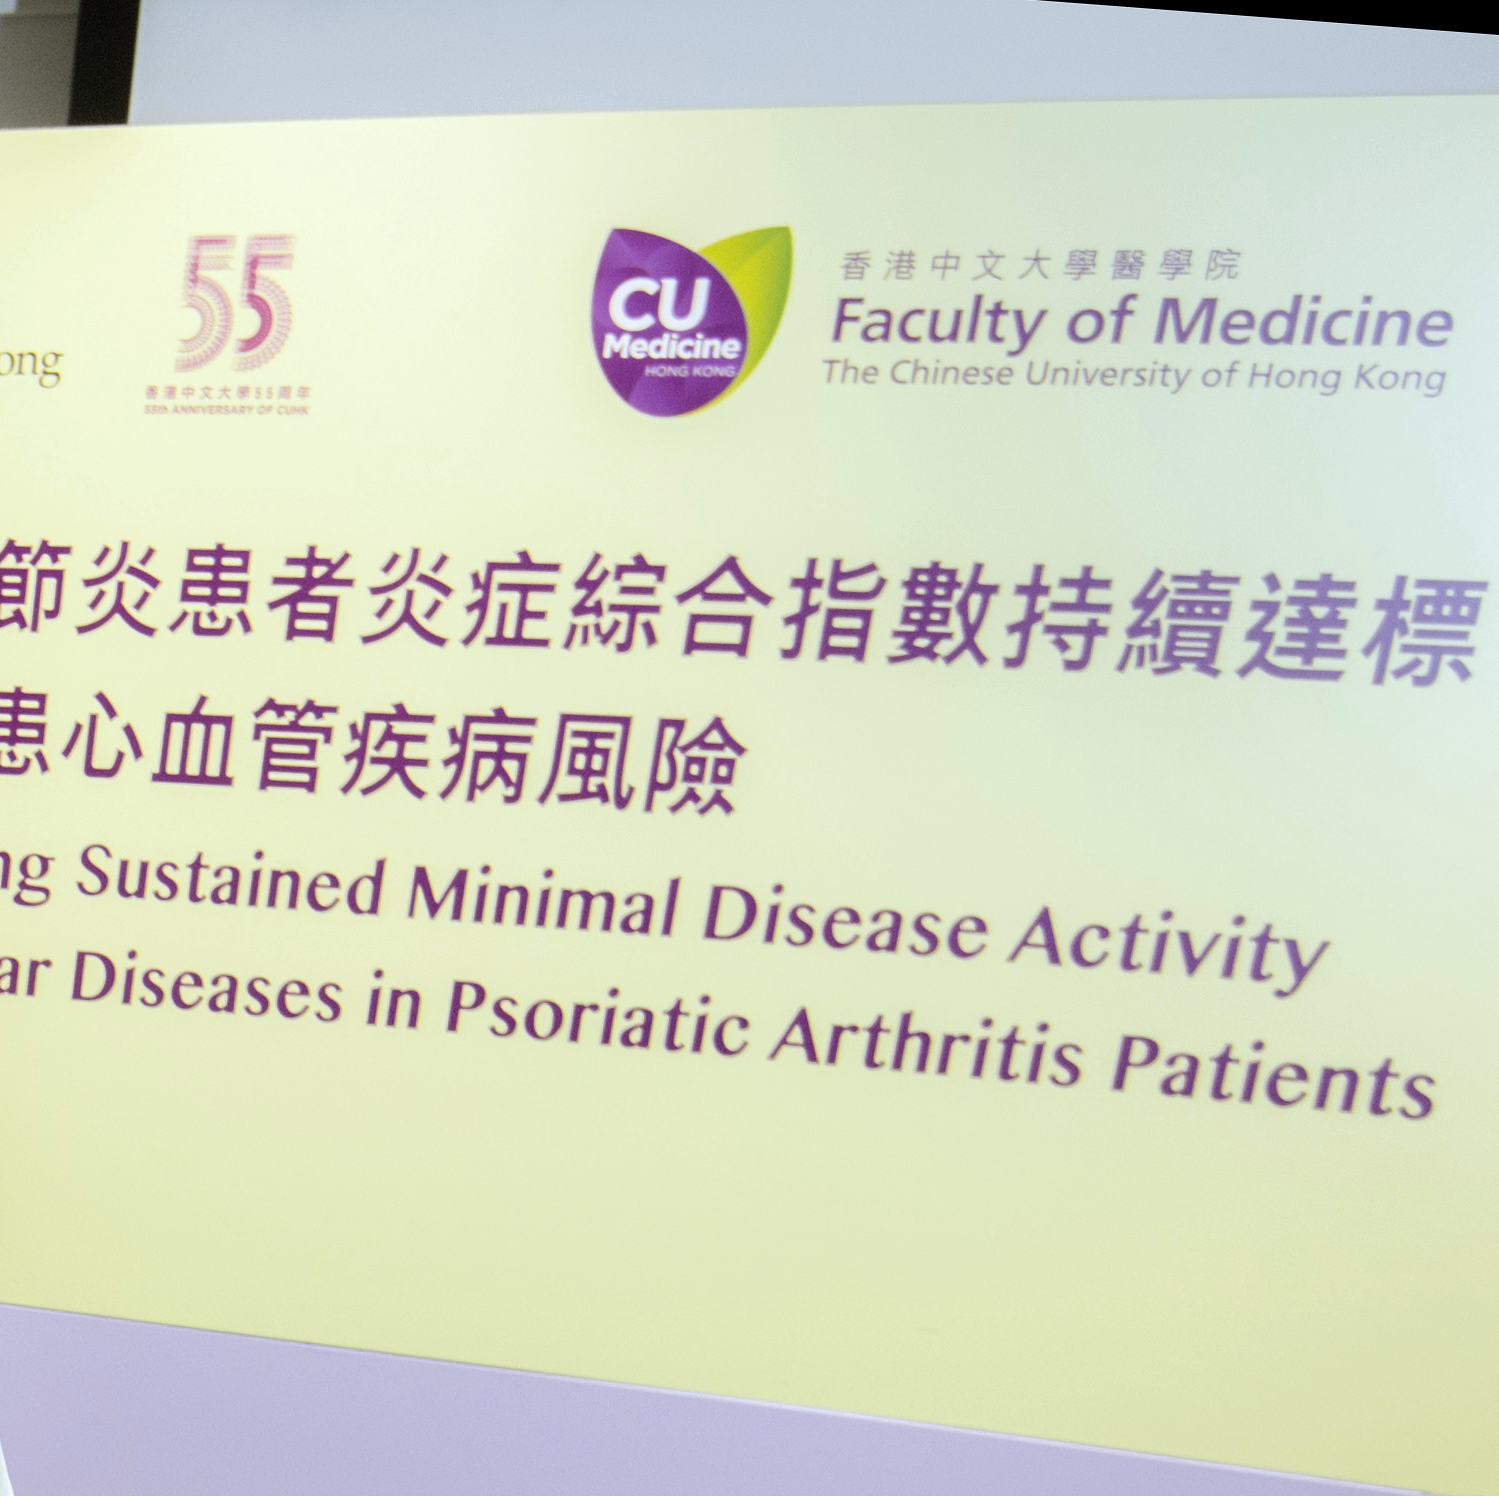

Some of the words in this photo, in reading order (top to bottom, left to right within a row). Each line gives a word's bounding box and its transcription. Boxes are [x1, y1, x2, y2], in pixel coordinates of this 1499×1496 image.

[840, 248, 1242, 282] 香港中文大學醫學院
[176, 235, 295, 373] 55
[609, 277, 711, 332] CU
[831, 293, 1048, 357] Faculty
[1067, 293, 1139, 344] of
[1154, 294, 1454, 347] Medicine
[603, 333, 742, 359] Medicine
[645, 365, 689, 378] HONG
[693, 365, 737, 379] KONG
[823, 358, 879, 385] The
[891, 359, 1014, 386] Chinese
[1026, 360, 1192, 395] University
[1202, 360, 1241, 388] of
[1248, 362, 1343, 397] Hong
[1354, 363, 1448, 399] Kong
[173, 405, 253, 416] ANNIVERSARY
[257, 405, 274, 416] OF
[277, 405, 310, 416] CUHK
[76, 844, 388, 917] Sustained
[407, 864, 683, 938] Minimal
[703, 883, 990, 962] Disease
[1006, 906, 1331, 1000] Activity
[71, 949, 344, 1024] Diseases
[367, 969, 422, 1030] in
[446, 980, 752, 1059] Psoriatic
[768, 1006, 1085, 1090] Arthritis
[1111, 1035, 1437, 1122] Patients
